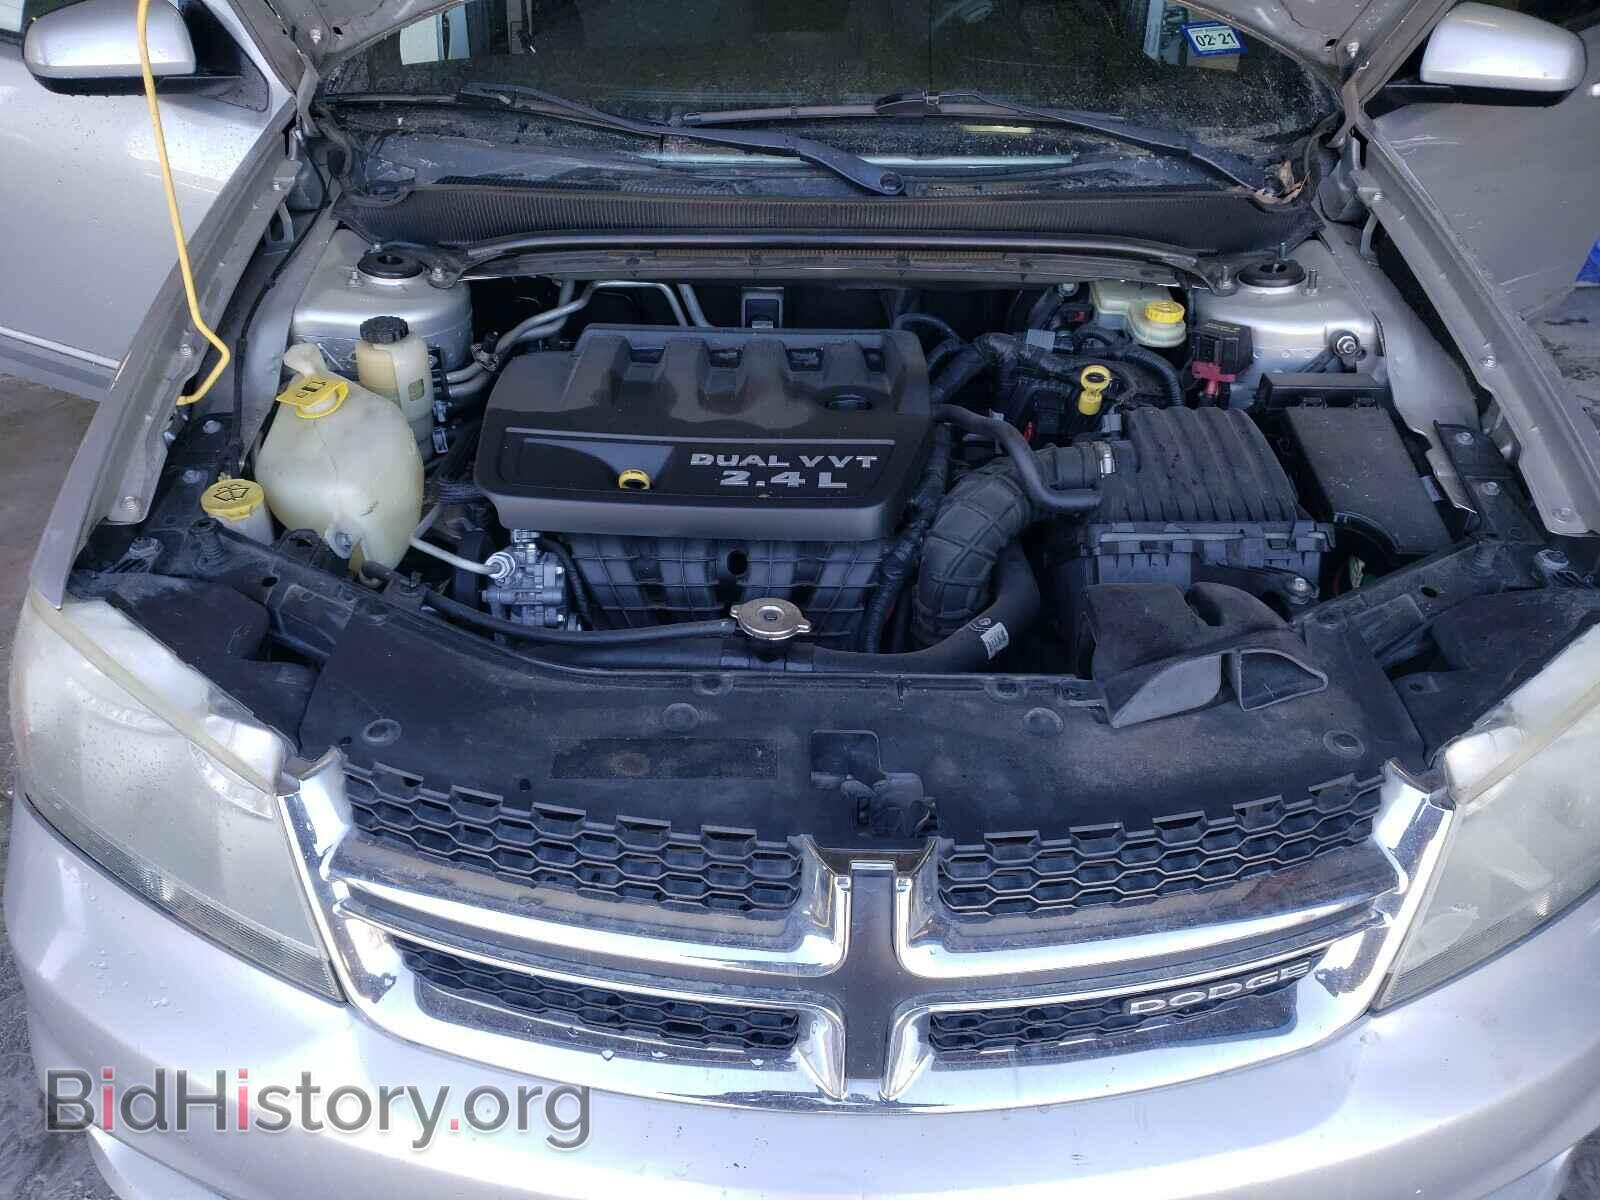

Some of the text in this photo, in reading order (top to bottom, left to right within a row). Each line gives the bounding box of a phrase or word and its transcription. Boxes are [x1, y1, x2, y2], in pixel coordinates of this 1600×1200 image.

[1195, 32, 1236, 47] 02 21
[690, 453, 878, 468] DUAL VVT
[1129, 961, 1311, 1015] DODGE
